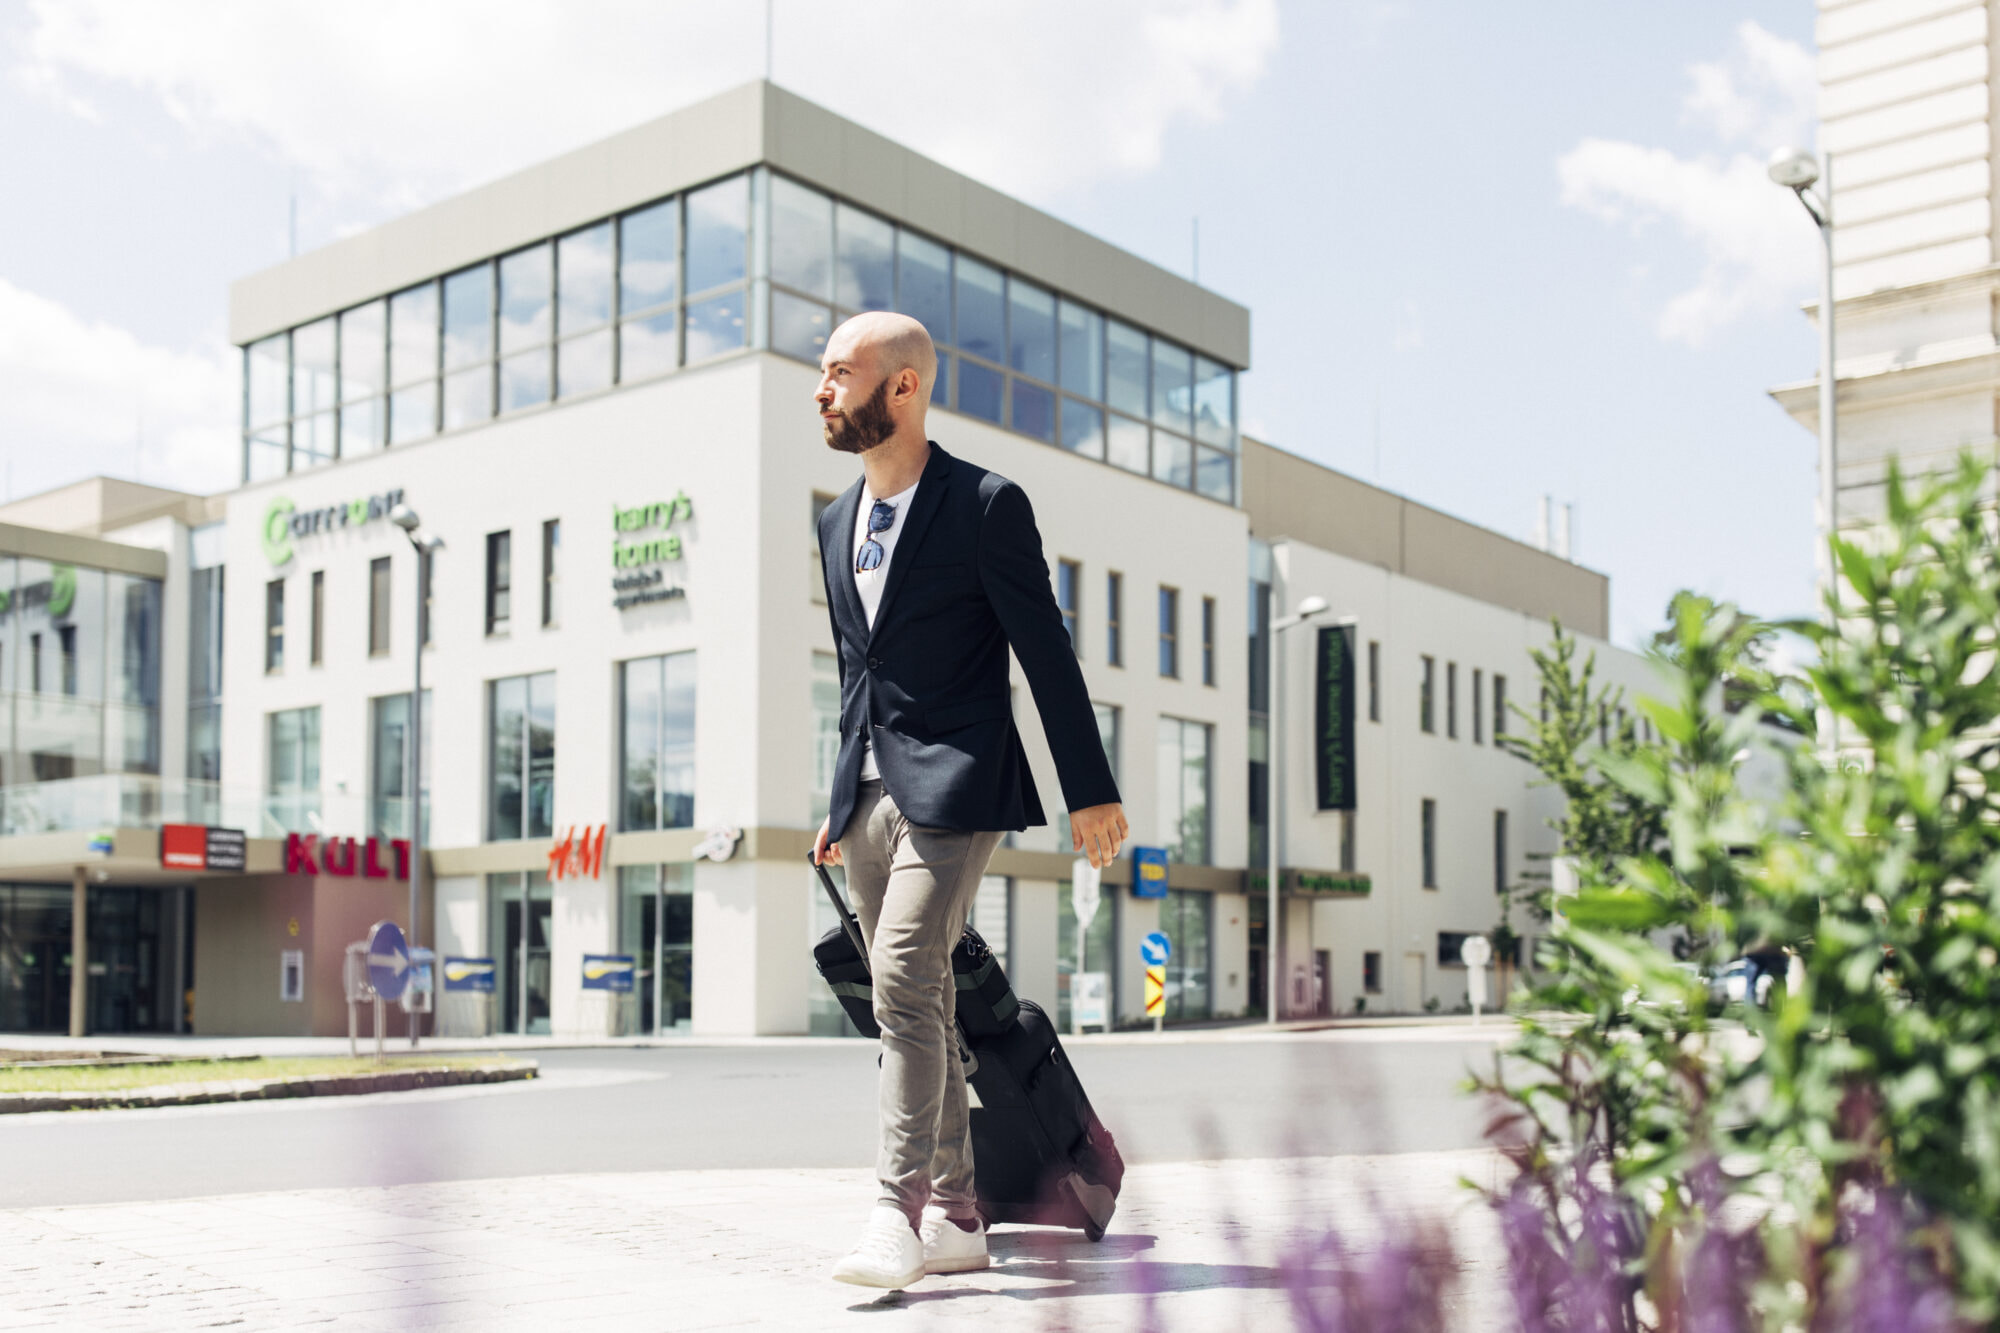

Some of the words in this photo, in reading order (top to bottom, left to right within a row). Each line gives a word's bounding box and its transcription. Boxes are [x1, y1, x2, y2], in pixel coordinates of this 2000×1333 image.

[613, 489, 692, 531] harry's
[613, 536, 682, 568] home
[284, 832, 411, 880] KULT
[546, 823, 606, 882] H&M
